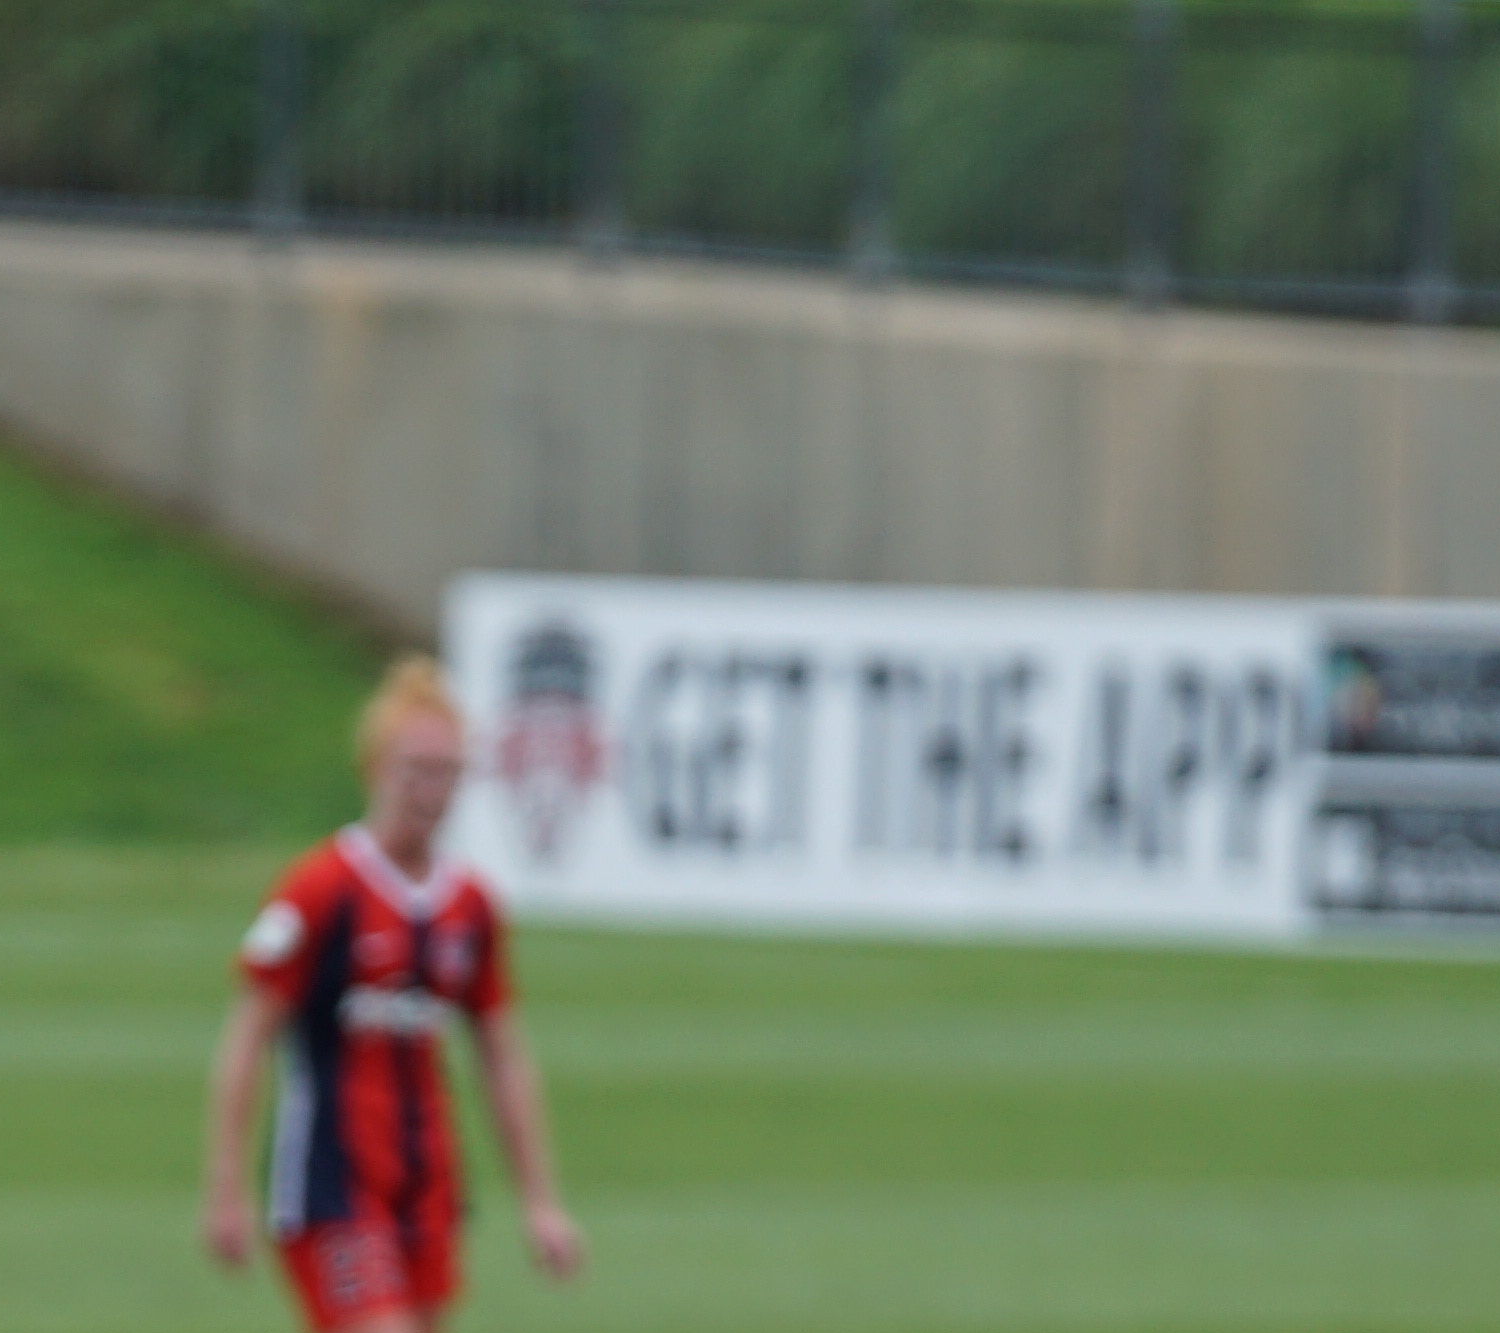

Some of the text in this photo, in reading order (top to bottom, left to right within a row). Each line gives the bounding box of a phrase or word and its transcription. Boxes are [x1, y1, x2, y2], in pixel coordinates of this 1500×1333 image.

[622, 638, 832, 864] GET
[836, 645, 1048, 868] THE
[1060, 655, 1306, 875] APP
